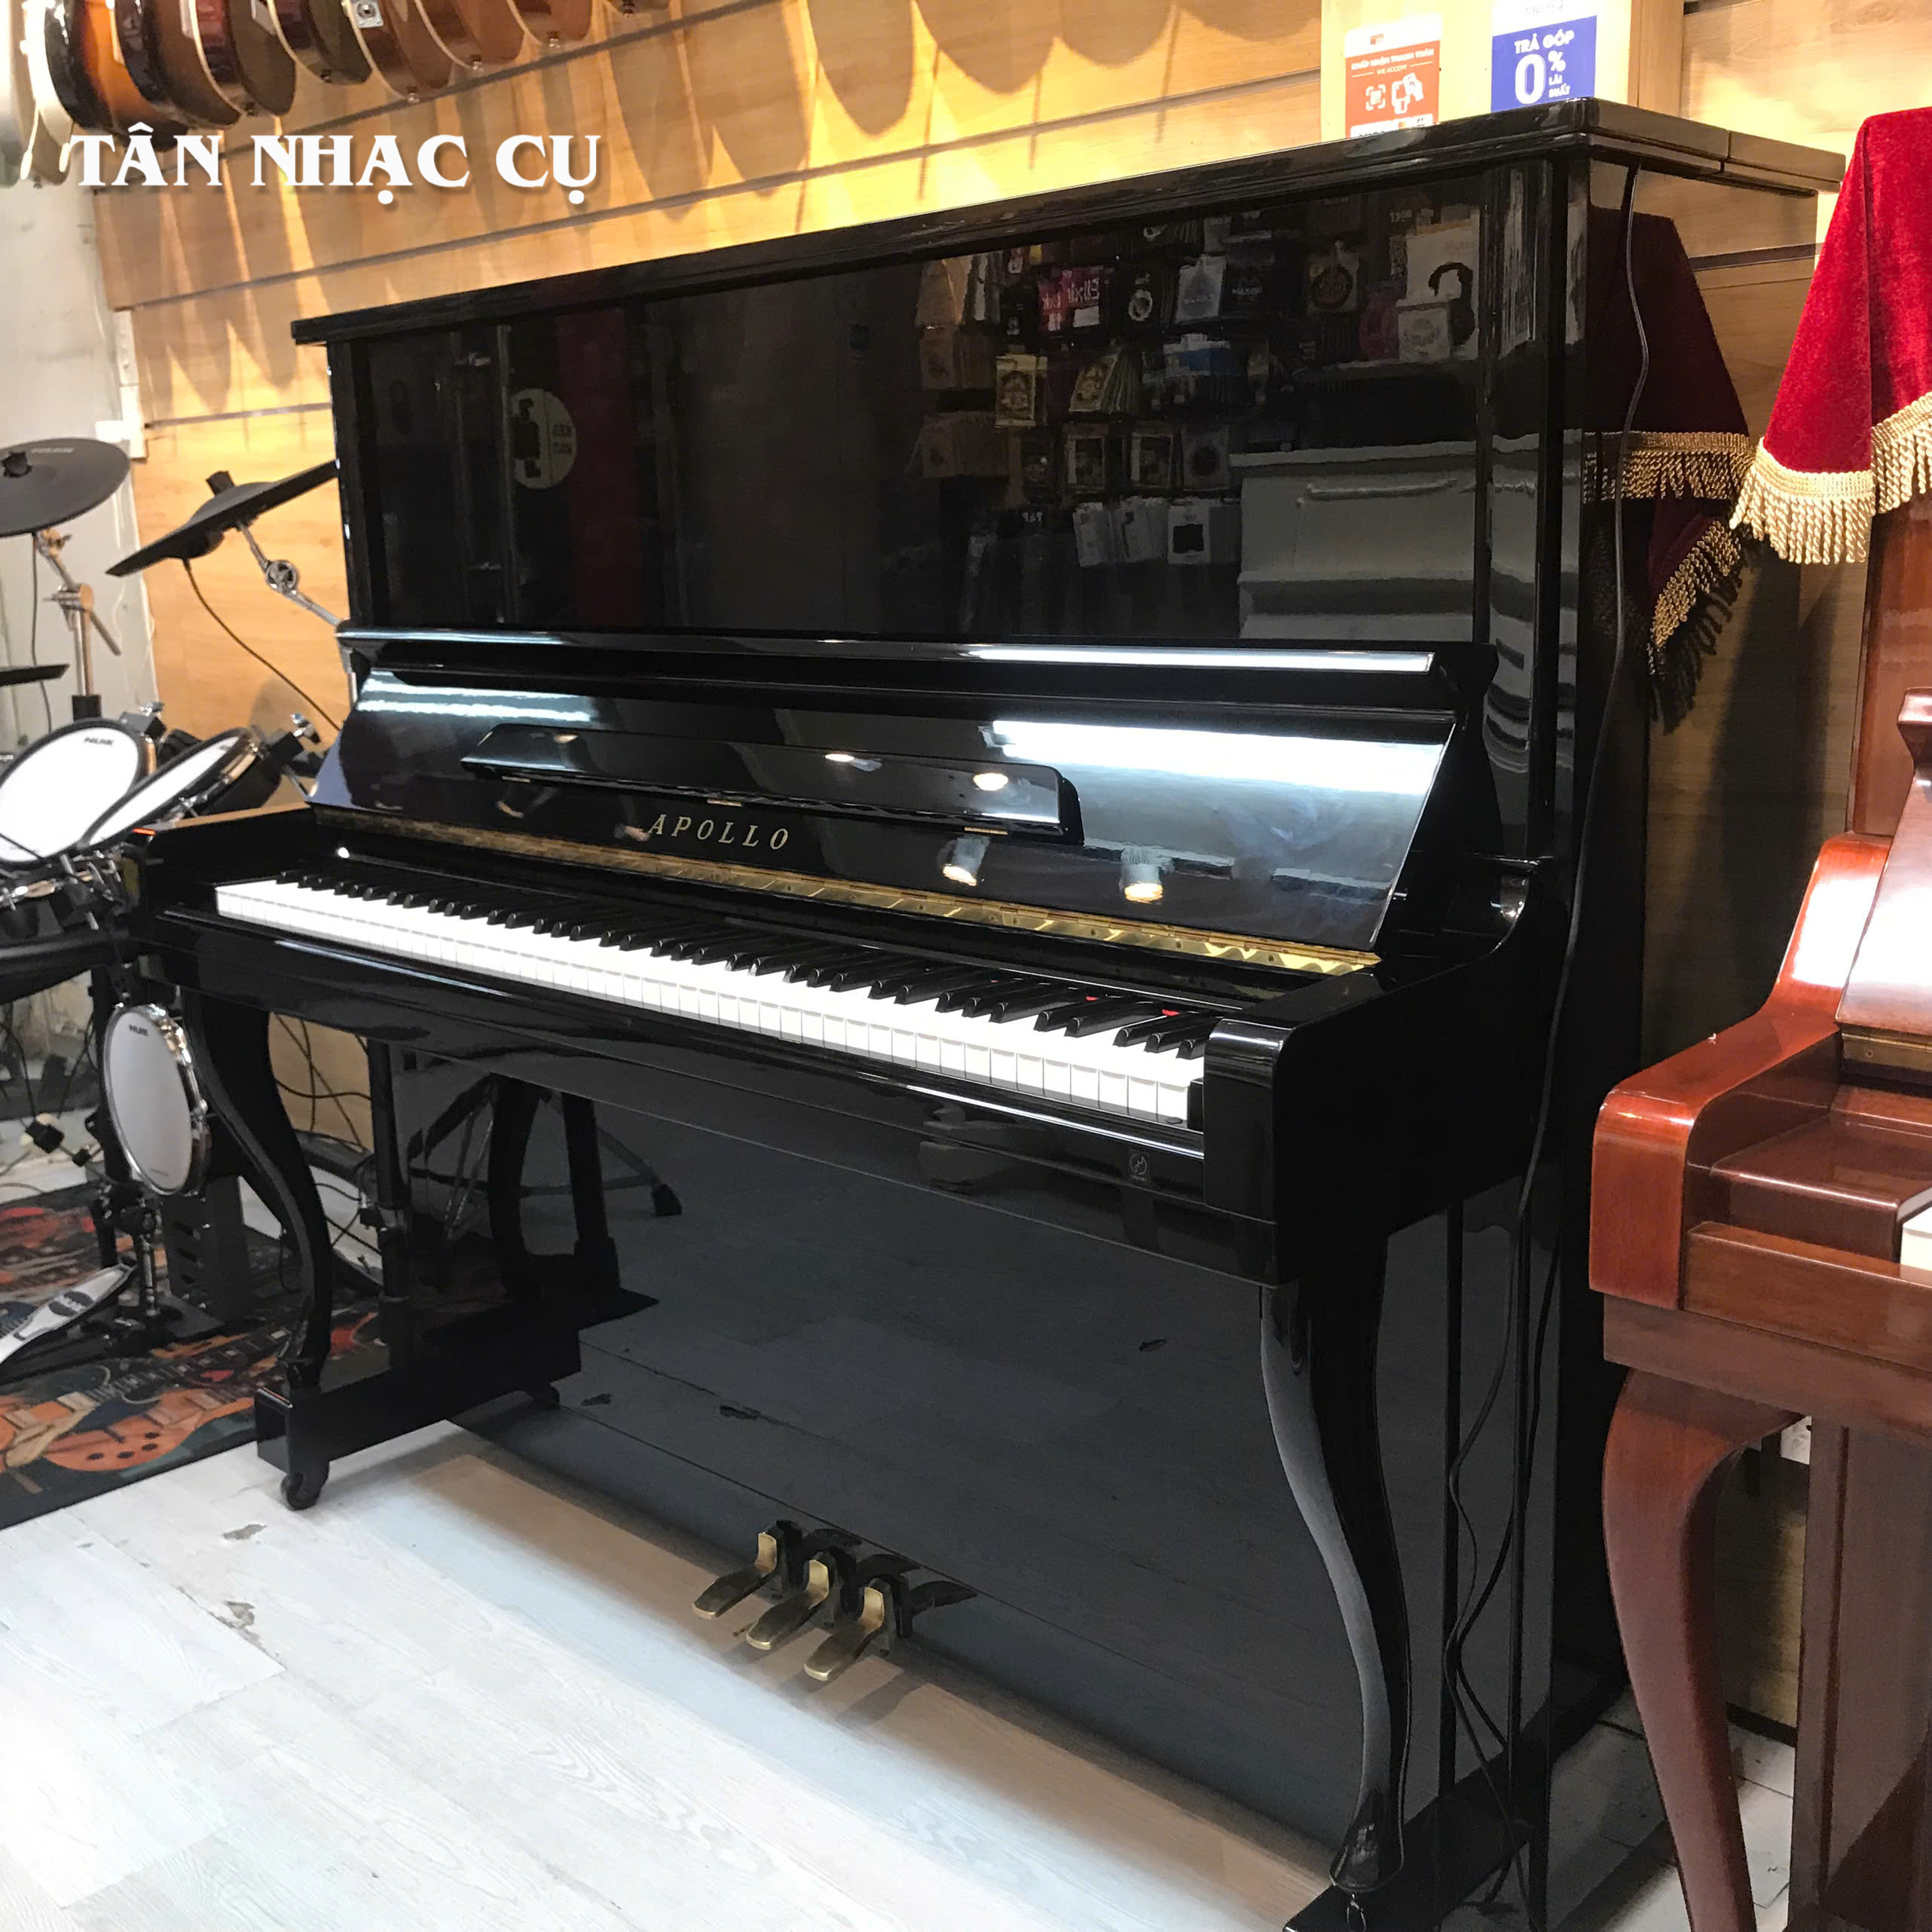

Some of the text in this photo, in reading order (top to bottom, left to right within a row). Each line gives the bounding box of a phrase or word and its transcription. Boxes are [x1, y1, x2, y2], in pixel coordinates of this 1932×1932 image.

[1514, 28, 1575, 54] TRẢ GÓP
[1386, 64, 1408, 73] ACCEPT
[647, 813, 789, 850] APOLLO
